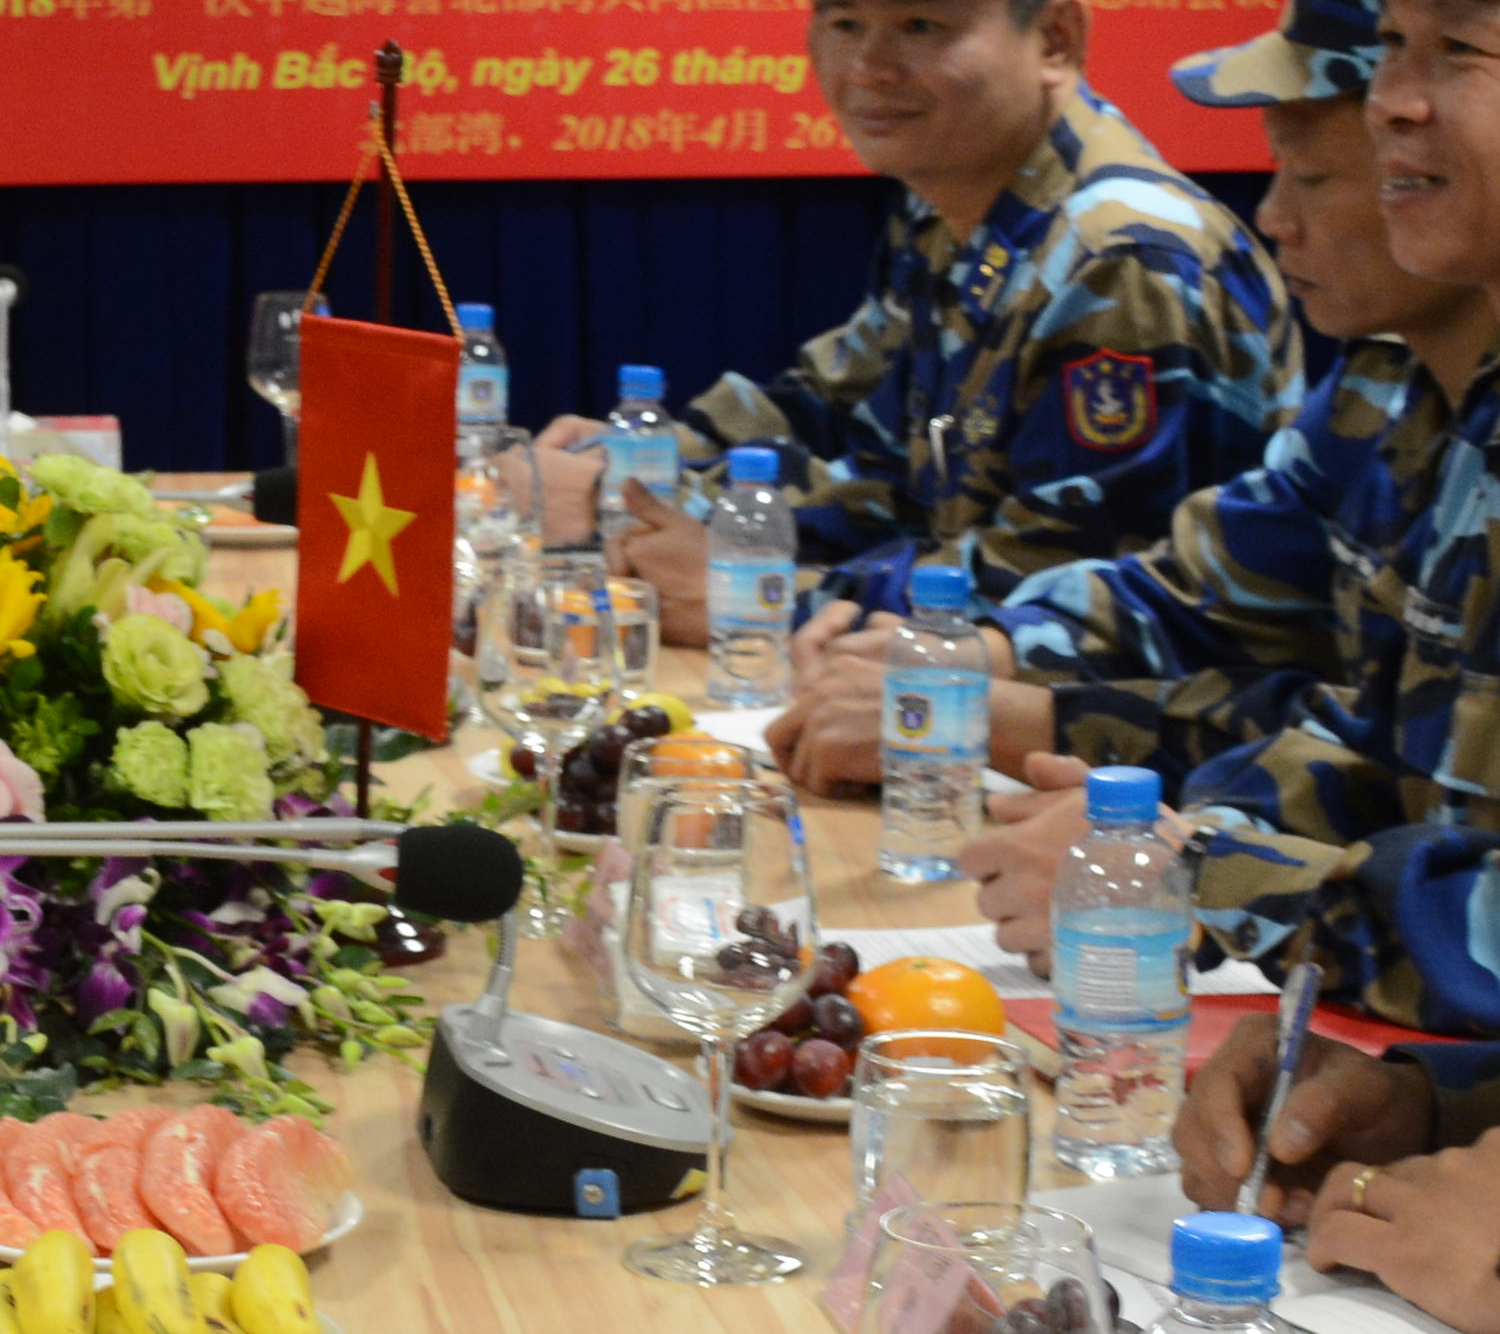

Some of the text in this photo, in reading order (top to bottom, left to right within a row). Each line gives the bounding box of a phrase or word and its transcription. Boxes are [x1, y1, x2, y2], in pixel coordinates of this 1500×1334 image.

[153, 51, 262, 100] Vịnh
[273, 42, 367, 90] Bắc
[472, 46, 591, 95] ngày
[603, 47, 661, 88] 26
[671, 45, 809, 94] tháng
